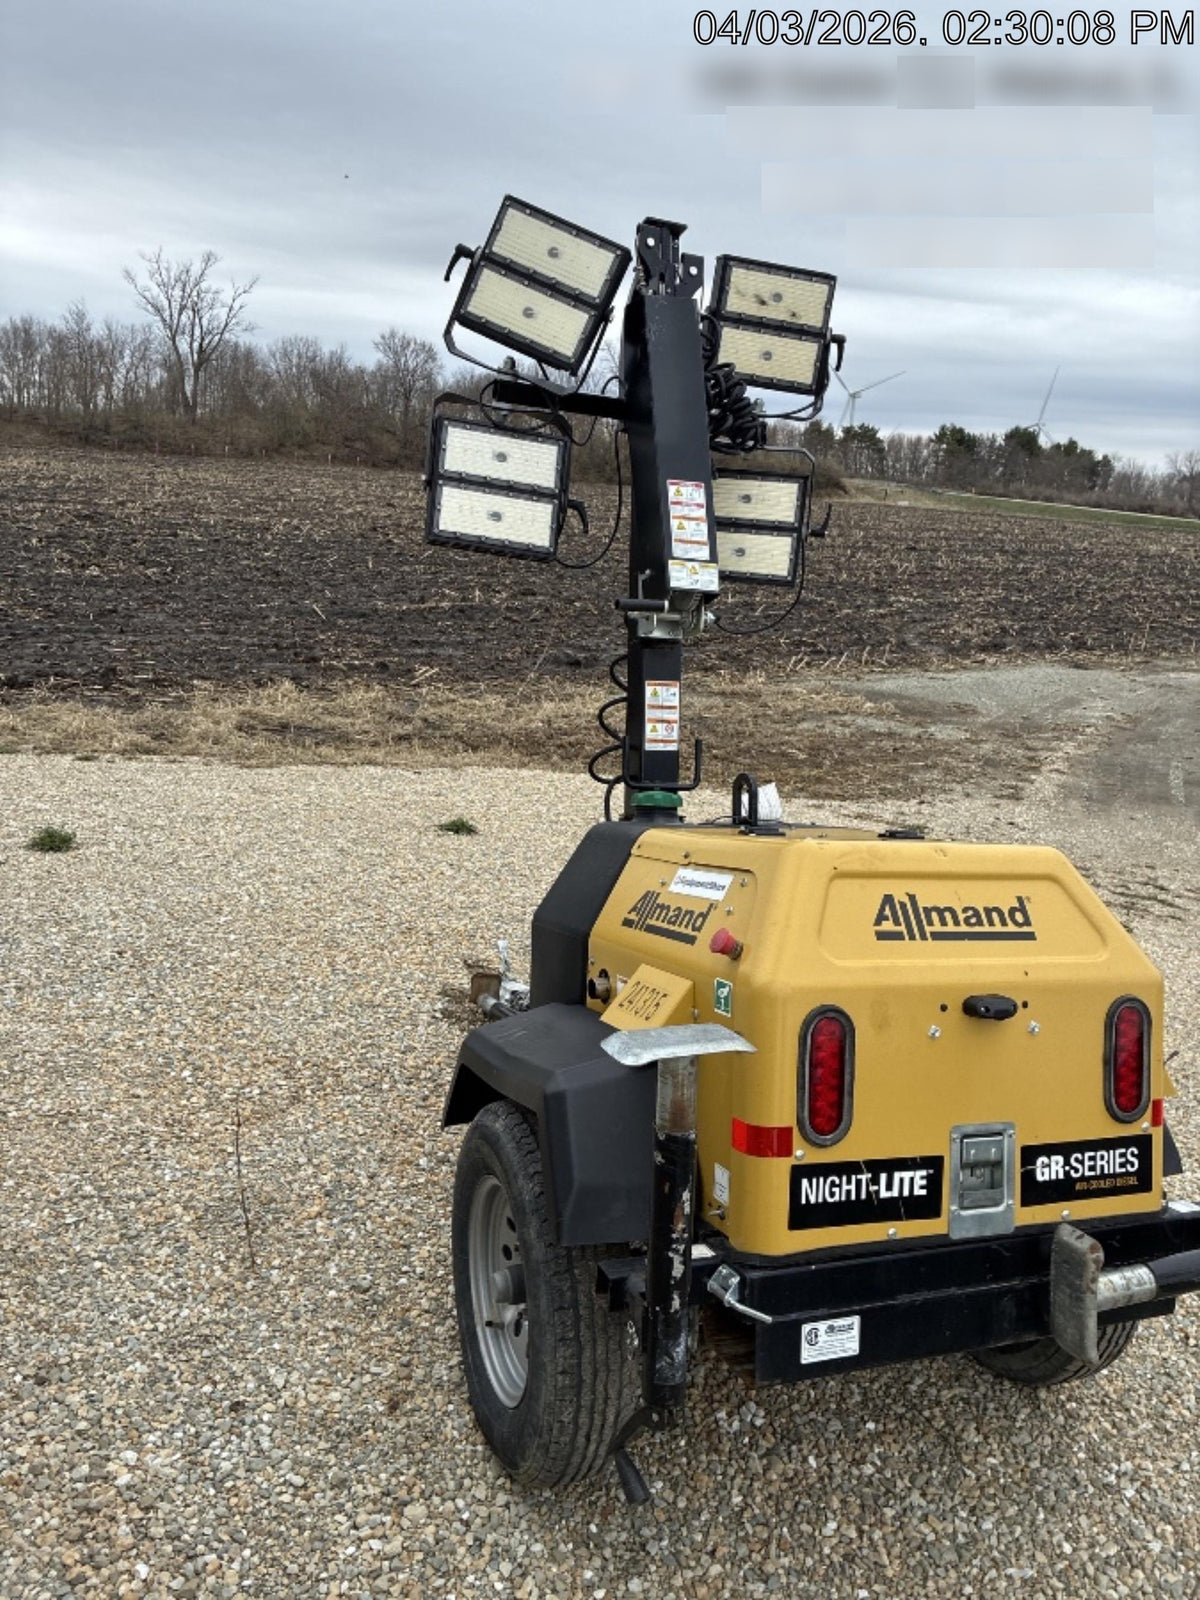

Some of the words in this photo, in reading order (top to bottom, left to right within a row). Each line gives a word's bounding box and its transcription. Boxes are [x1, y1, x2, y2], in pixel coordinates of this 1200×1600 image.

[627, 890, 717, 932] Allmand
[873, 892, 1033, 941] Allmand
[801, 1169, 928, 1205] NIGHT-LITE
